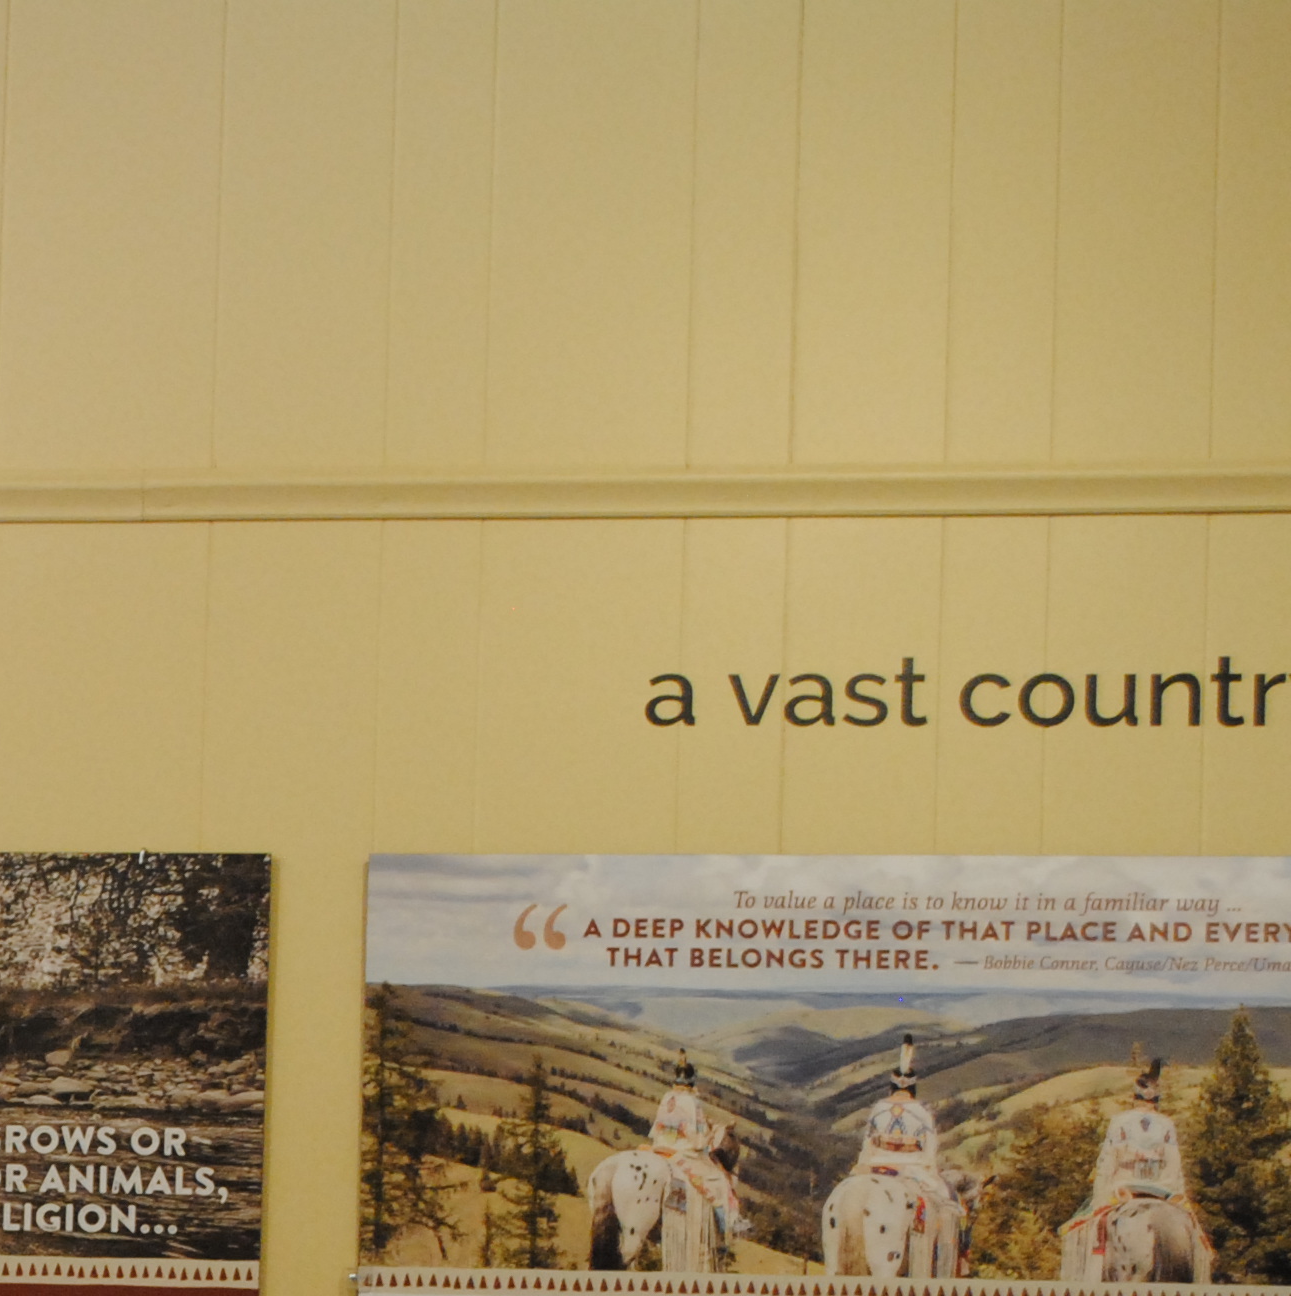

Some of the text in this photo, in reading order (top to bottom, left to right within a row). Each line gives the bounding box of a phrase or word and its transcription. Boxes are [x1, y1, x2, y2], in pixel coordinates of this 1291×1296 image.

[644, 656, 1291, 728] a vast countr
[733, 889, 757, 909] To
[763, 889, 817, 910] value
[823, 896, 835, 910] a
[841, 888, 896, 917] place
[902, 891, 919, 910] is
[925, 895, 945, 910] to
[950, 890, 1009, 911] know
[1014, 892, 1030, 912] it
[1036, 892, 1057, 911] in
[1063, 897, 1077, 911] a
[1079, 890, 1170, 917] familiar
[1176, 898, 1221, 919] way
[582, 917, 1291, 943] A DEEP KNOWLEDGE OF THAT PLACE AND EVERY
[606, 946, 939, 970] THAT BELONGS THERE.
[131, 1126, 187, 1157] OR
[39, 1164, 229, 1204] ANIMALS,
